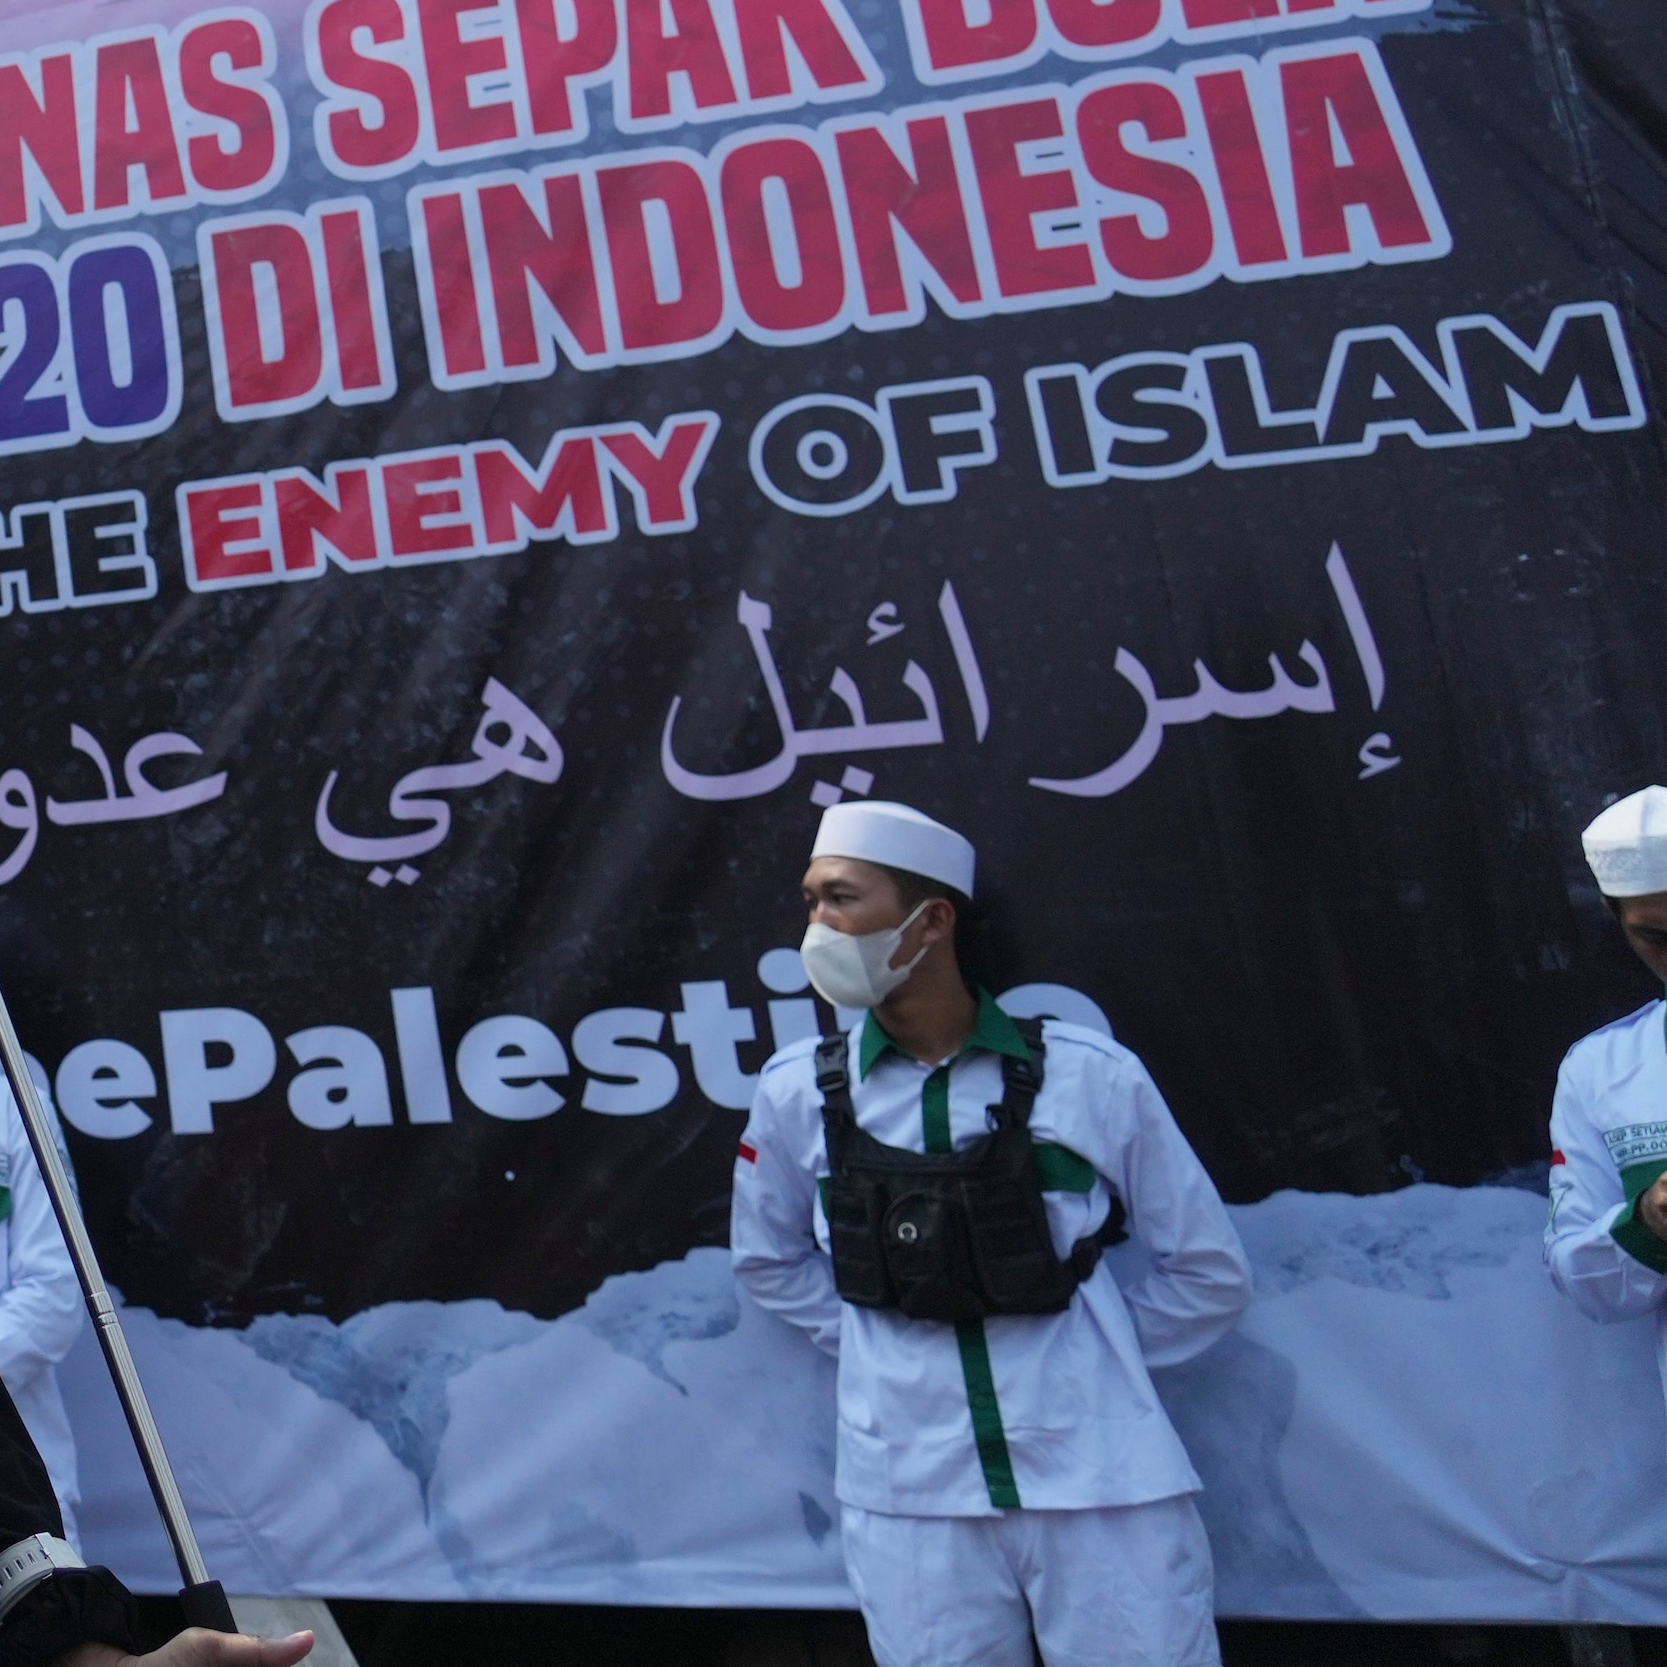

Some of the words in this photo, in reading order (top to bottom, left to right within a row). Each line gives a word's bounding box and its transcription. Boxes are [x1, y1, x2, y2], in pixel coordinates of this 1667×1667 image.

[207, 202, 385, 412] DI
[415, 47, 1441, 382] INDONESIA
[179, 416, 713, 589] ENEMY
[752, 378, 995, 514] OF
[1030, 305, 1644, 486] ISLAM
[315, 677, 564, 886] هي
